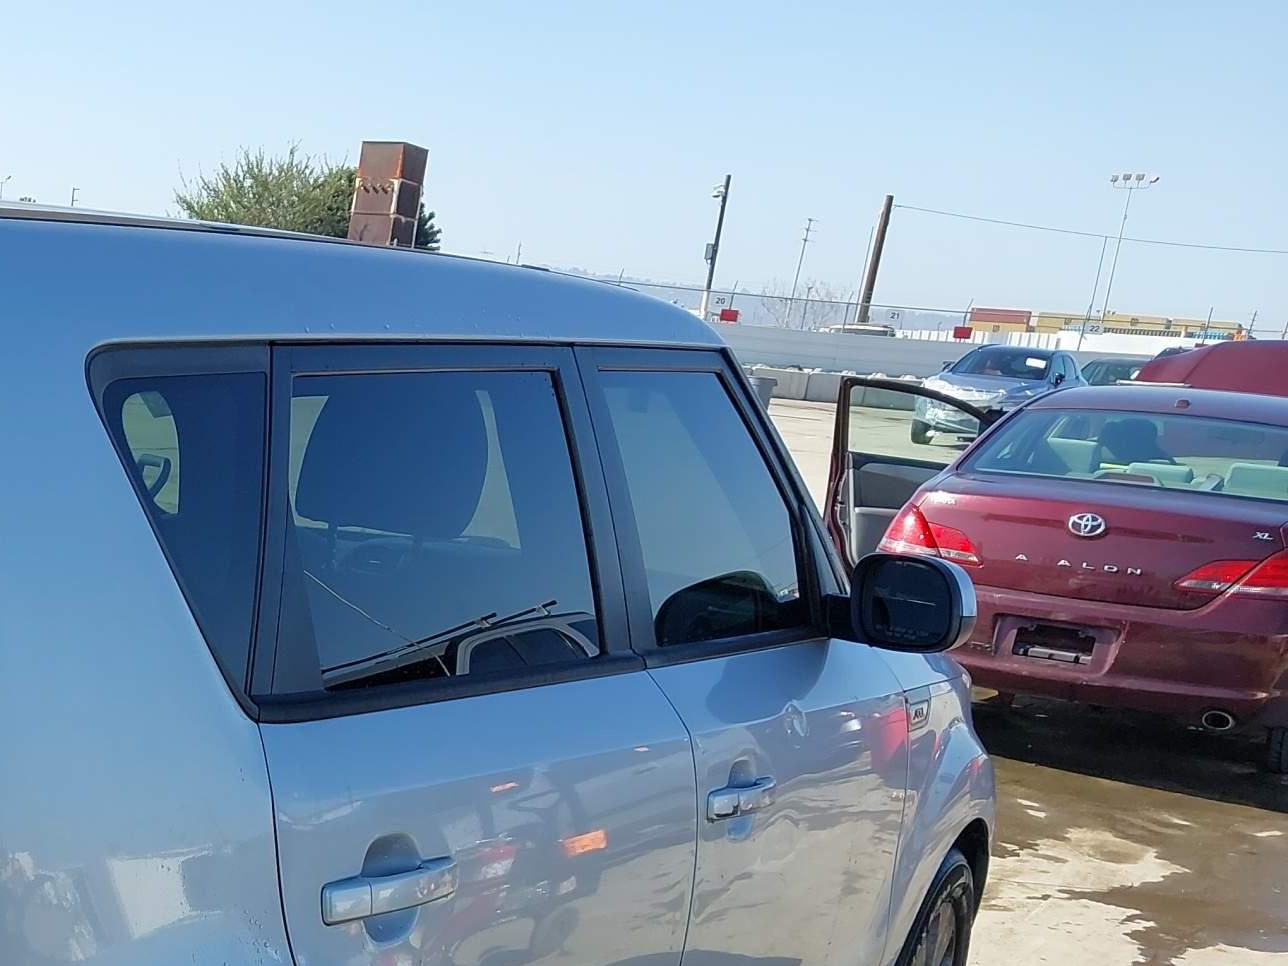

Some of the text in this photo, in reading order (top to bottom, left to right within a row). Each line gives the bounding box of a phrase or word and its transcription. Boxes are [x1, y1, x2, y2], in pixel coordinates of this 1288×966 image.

[715, 297, 726, 305] 20
[889, 312, 900, 320] 21
[1252, 531, 1274, 541] XL
